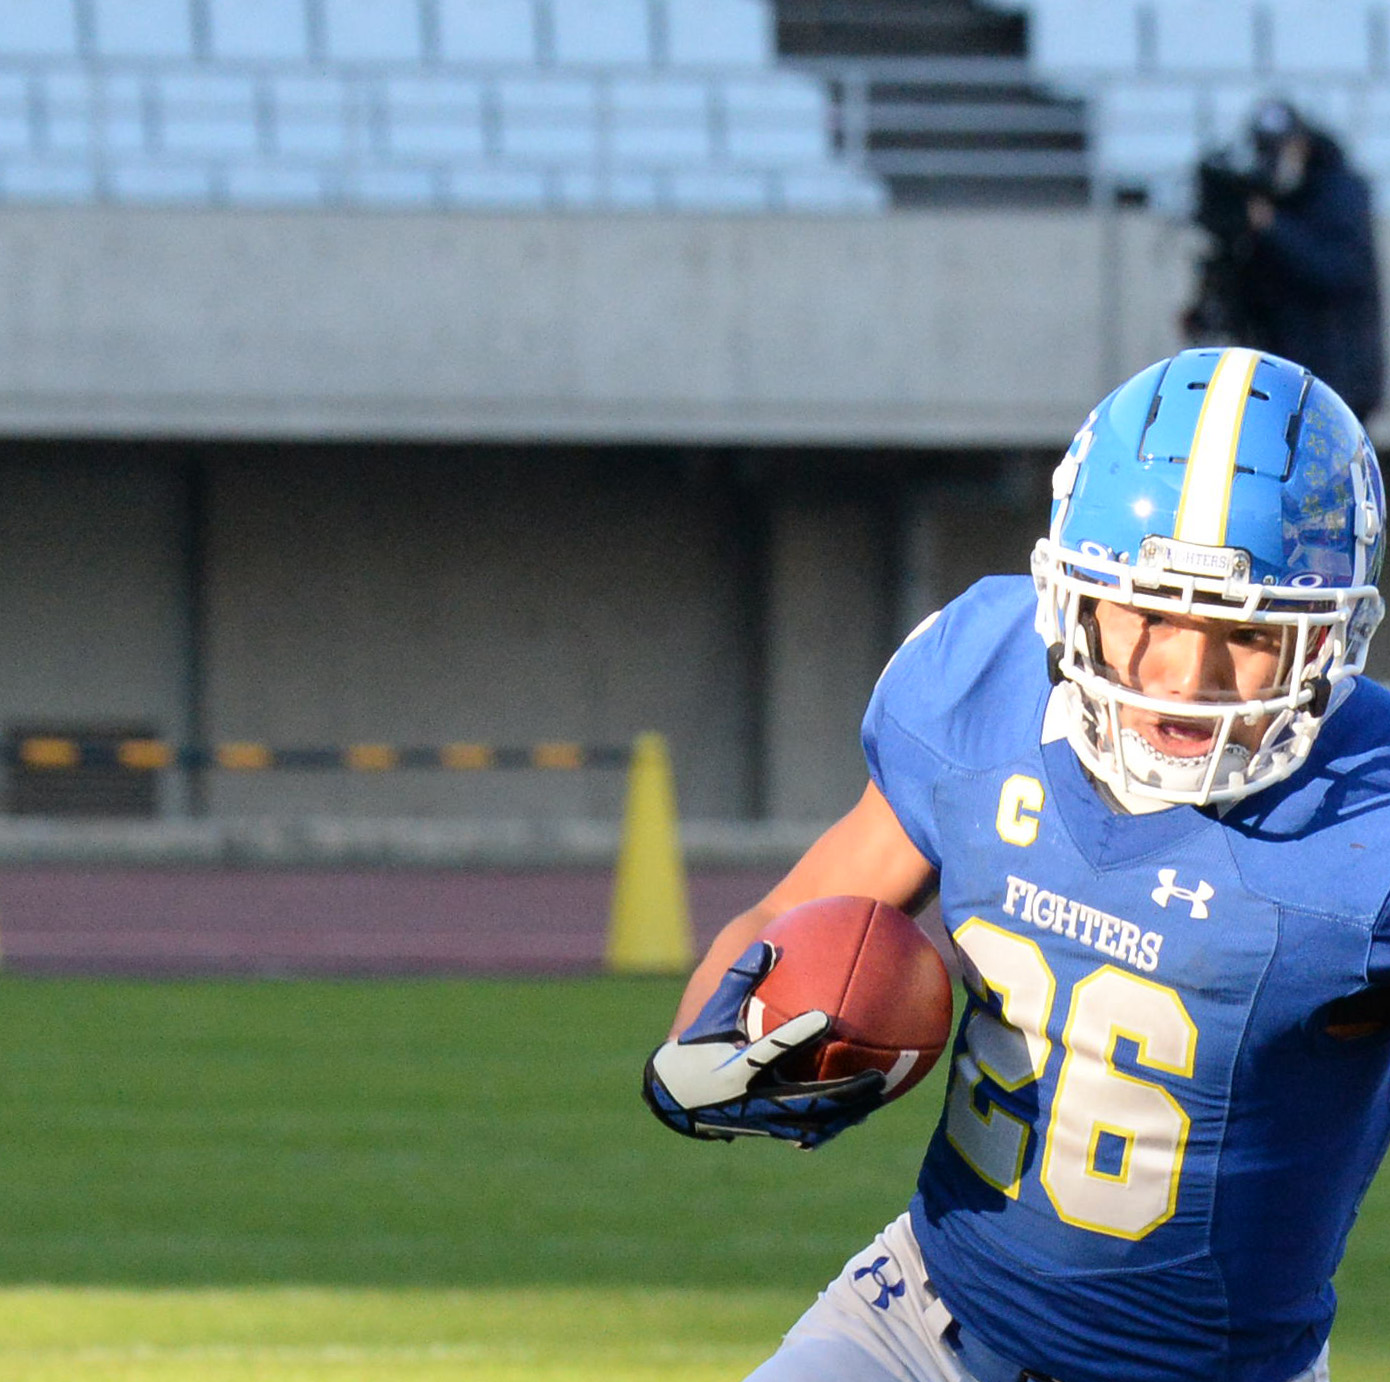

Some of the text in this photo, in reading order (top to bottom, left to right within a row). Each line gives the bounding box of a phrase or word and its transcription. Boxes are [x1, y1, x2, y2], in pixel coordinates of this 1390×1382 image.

[995, 773, 1046, 848] C
[1002, 874, 1164, 972] FIGHTERS
[945, 915, 1199, 1242] 26
